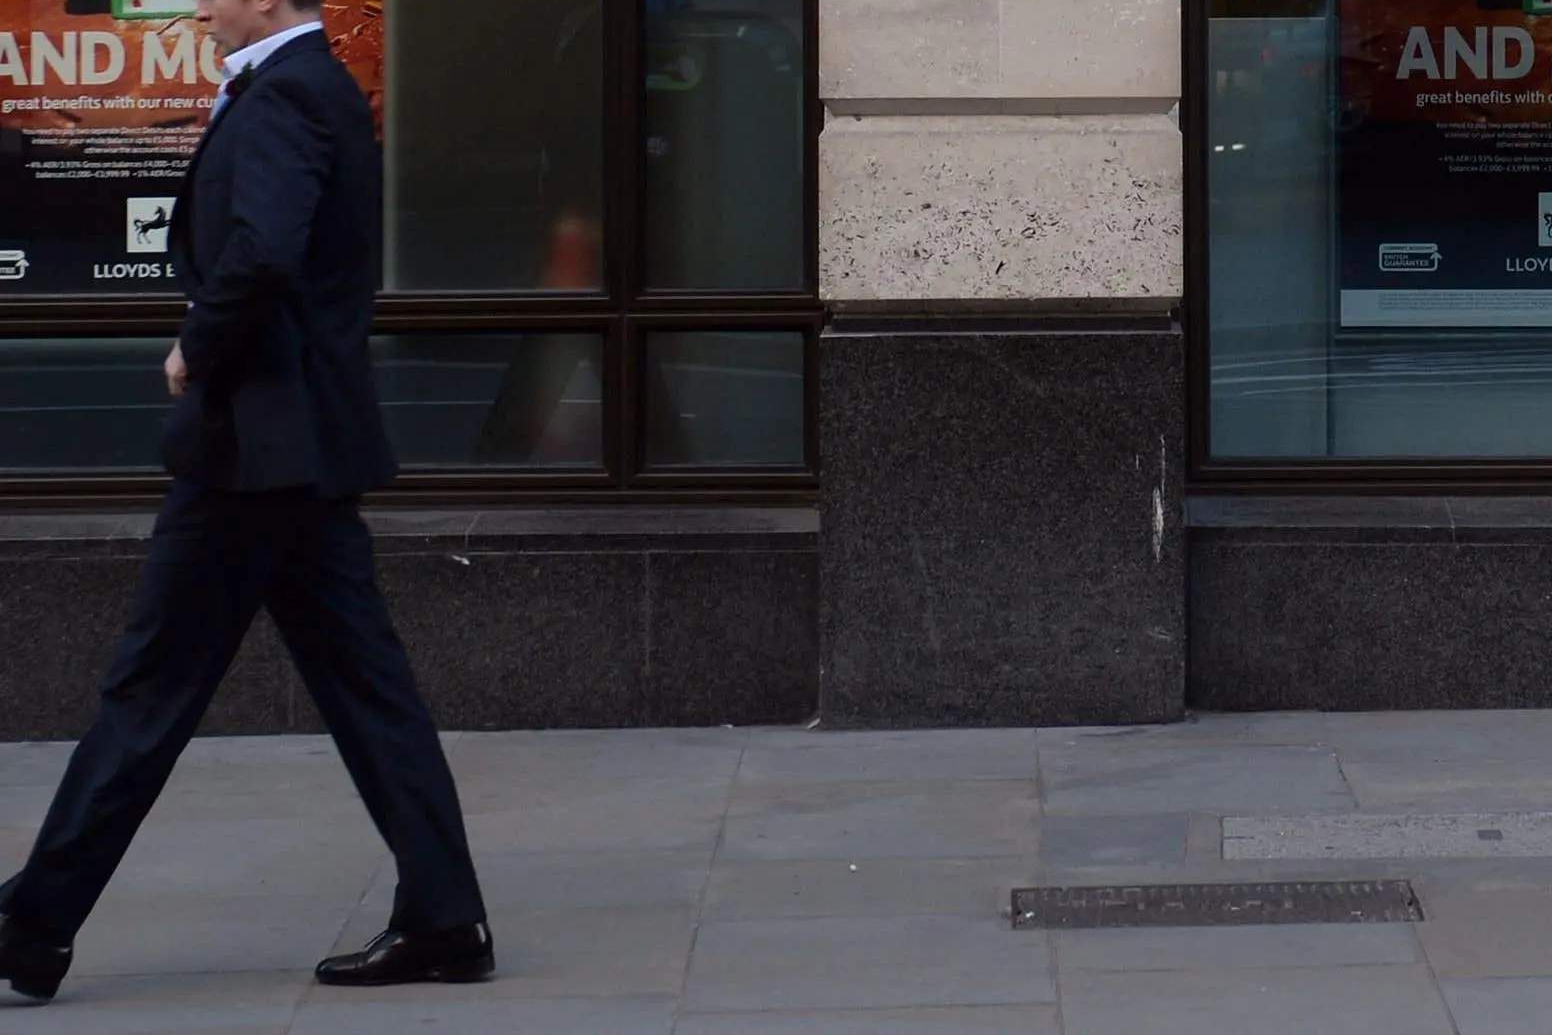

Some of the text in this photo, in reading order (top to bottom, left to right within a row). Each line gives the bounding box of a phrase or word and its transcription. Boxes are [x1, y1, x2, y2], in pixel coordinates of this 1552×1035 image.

[1395, 26, 1536, 80] AND
[2, 97, 40, 113] great
[42, 95, 101, 110] benefits
[103, 95, 135, 109] with
[137, 98, 162, 109] our
[164, 98, 195, 109] new
[1416, 92, 1452, 108] great
[1455, 90, 1512, 104] benefits
[1514, 90, 1545, 104] with
[94, 263, 162, 279] LLOYDS
